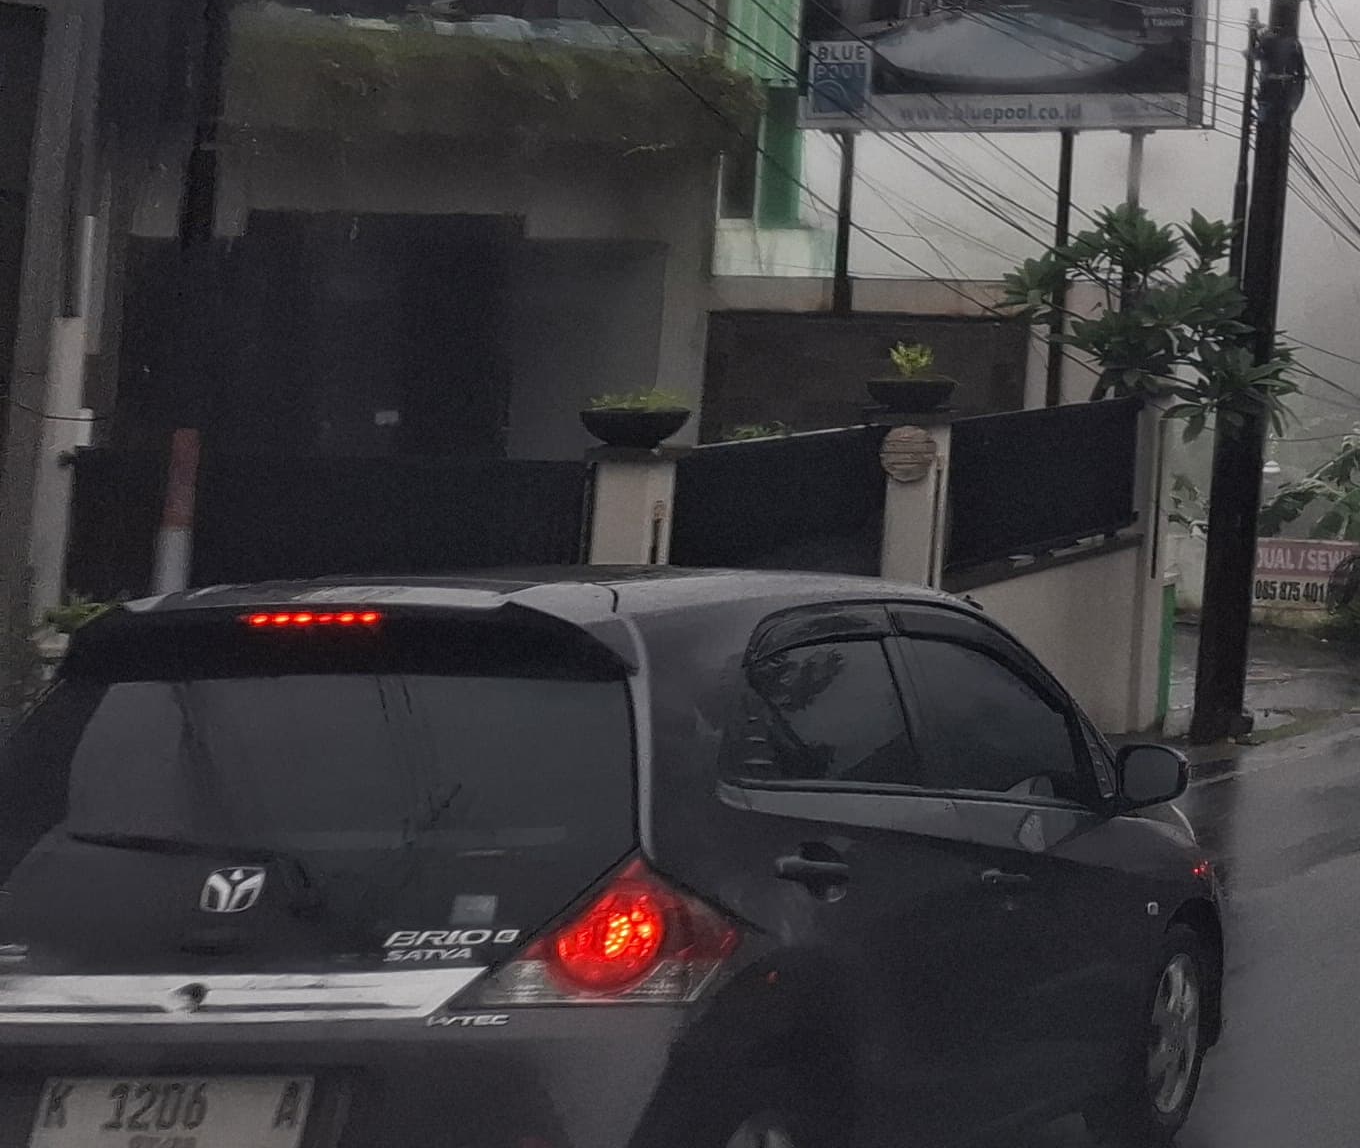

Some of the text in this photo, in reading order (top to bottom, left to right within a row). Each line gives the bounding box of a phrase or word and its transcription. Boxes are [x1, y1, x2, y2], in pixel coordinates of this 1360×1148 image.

[818, 45, 865, 61] BLUE
[383, 929, 493, 948] BRIO
[382, 947, 473, 962] SATYA
[43, 1080, 75, 1130] K
